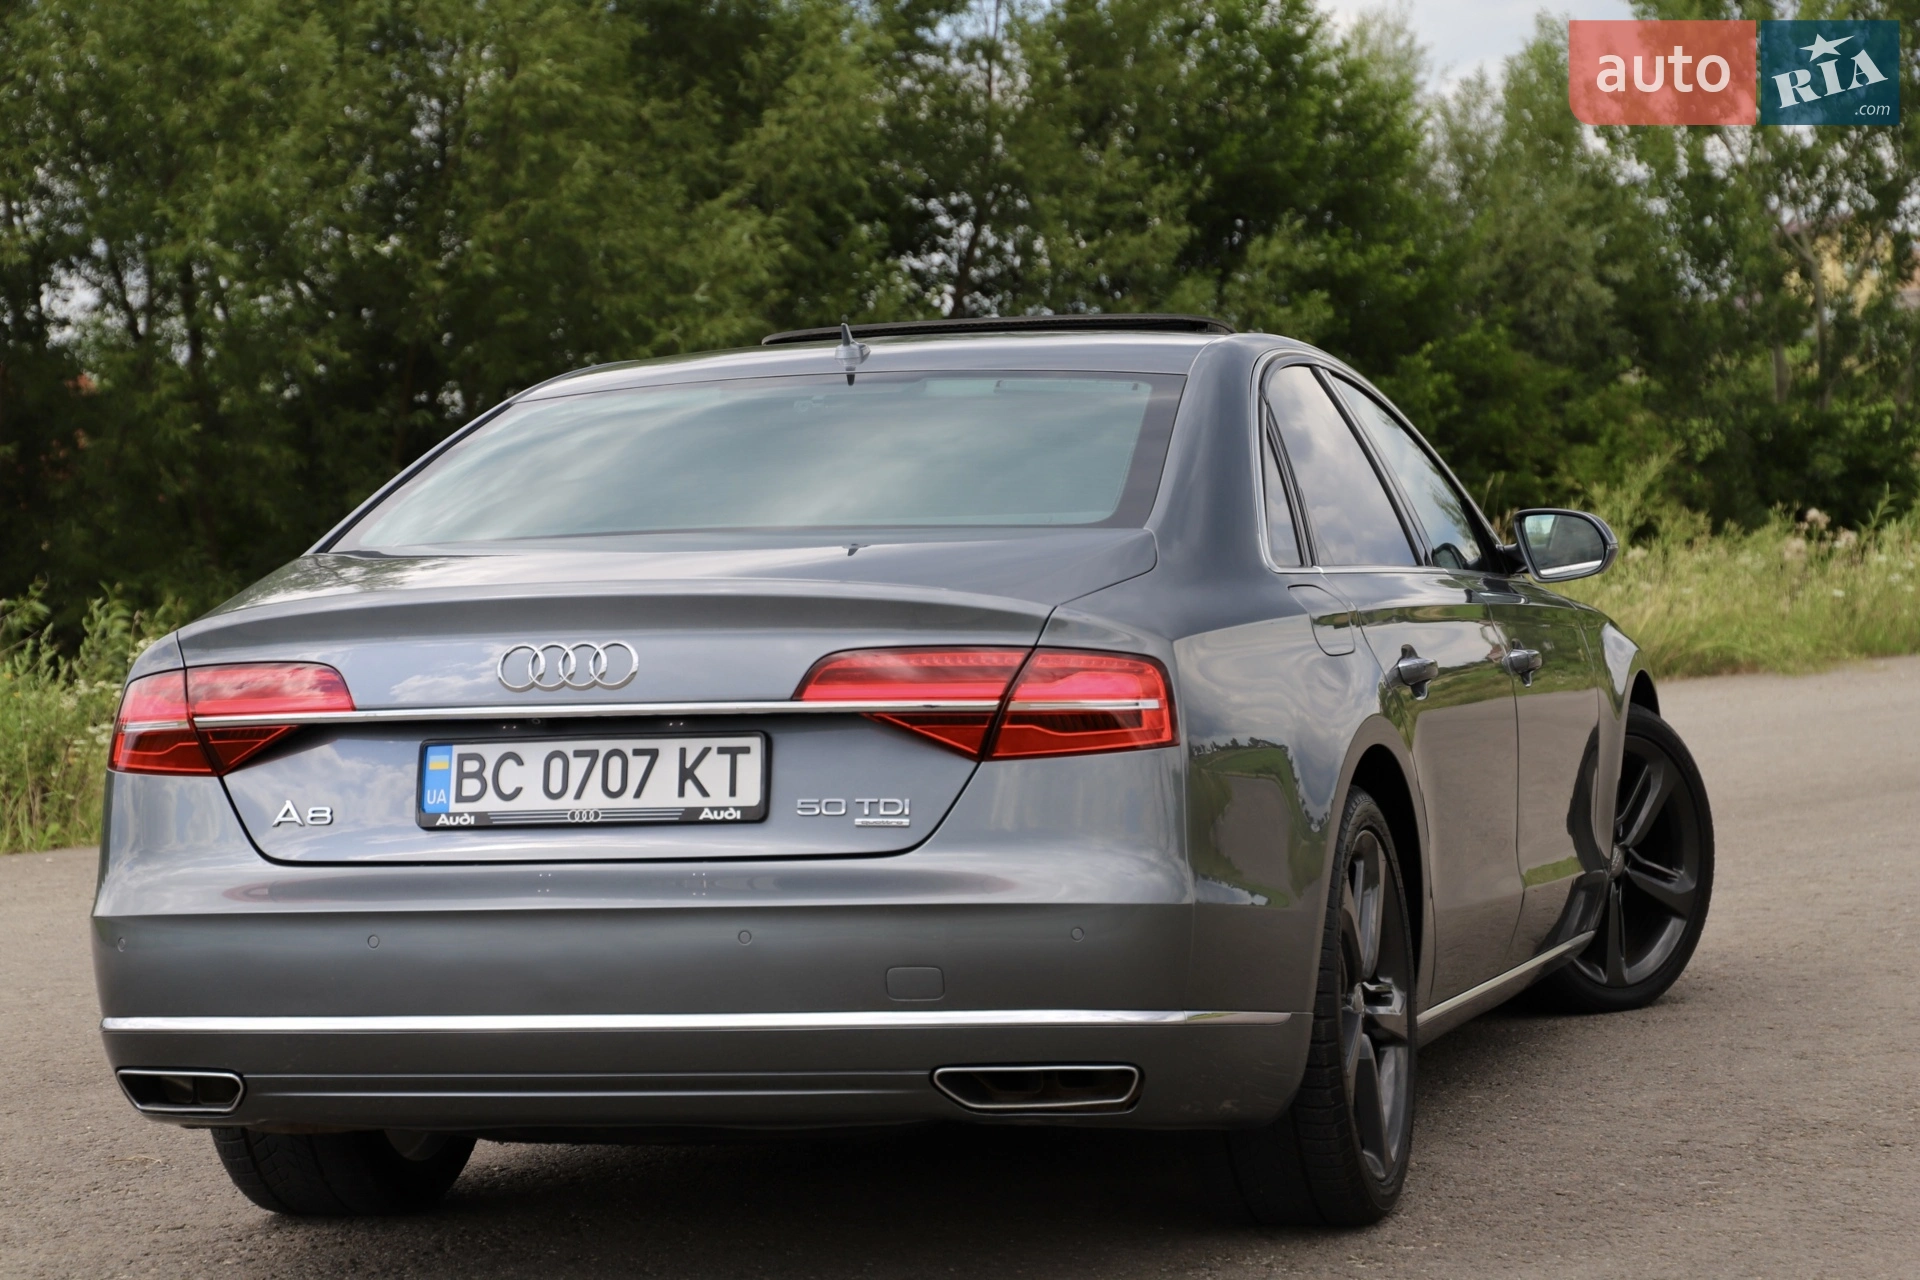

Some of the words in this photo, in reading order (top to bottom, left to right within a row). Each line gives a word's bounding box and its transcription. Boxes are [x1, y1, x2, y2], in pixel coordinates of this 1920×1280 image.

[455, 752, 524, 803] BC
[542, 749, 659, 800] 0707
[678, 746, 750, 798] KT
[427, 789, 447, 805] UA
[272, 800, 333, 827] A8
[699, 807, 741, 821] Audi
[797, 799, 846, 816] 50
[855, 799, 909, 816] TDI
[436, 813, 475, 826] Audi
